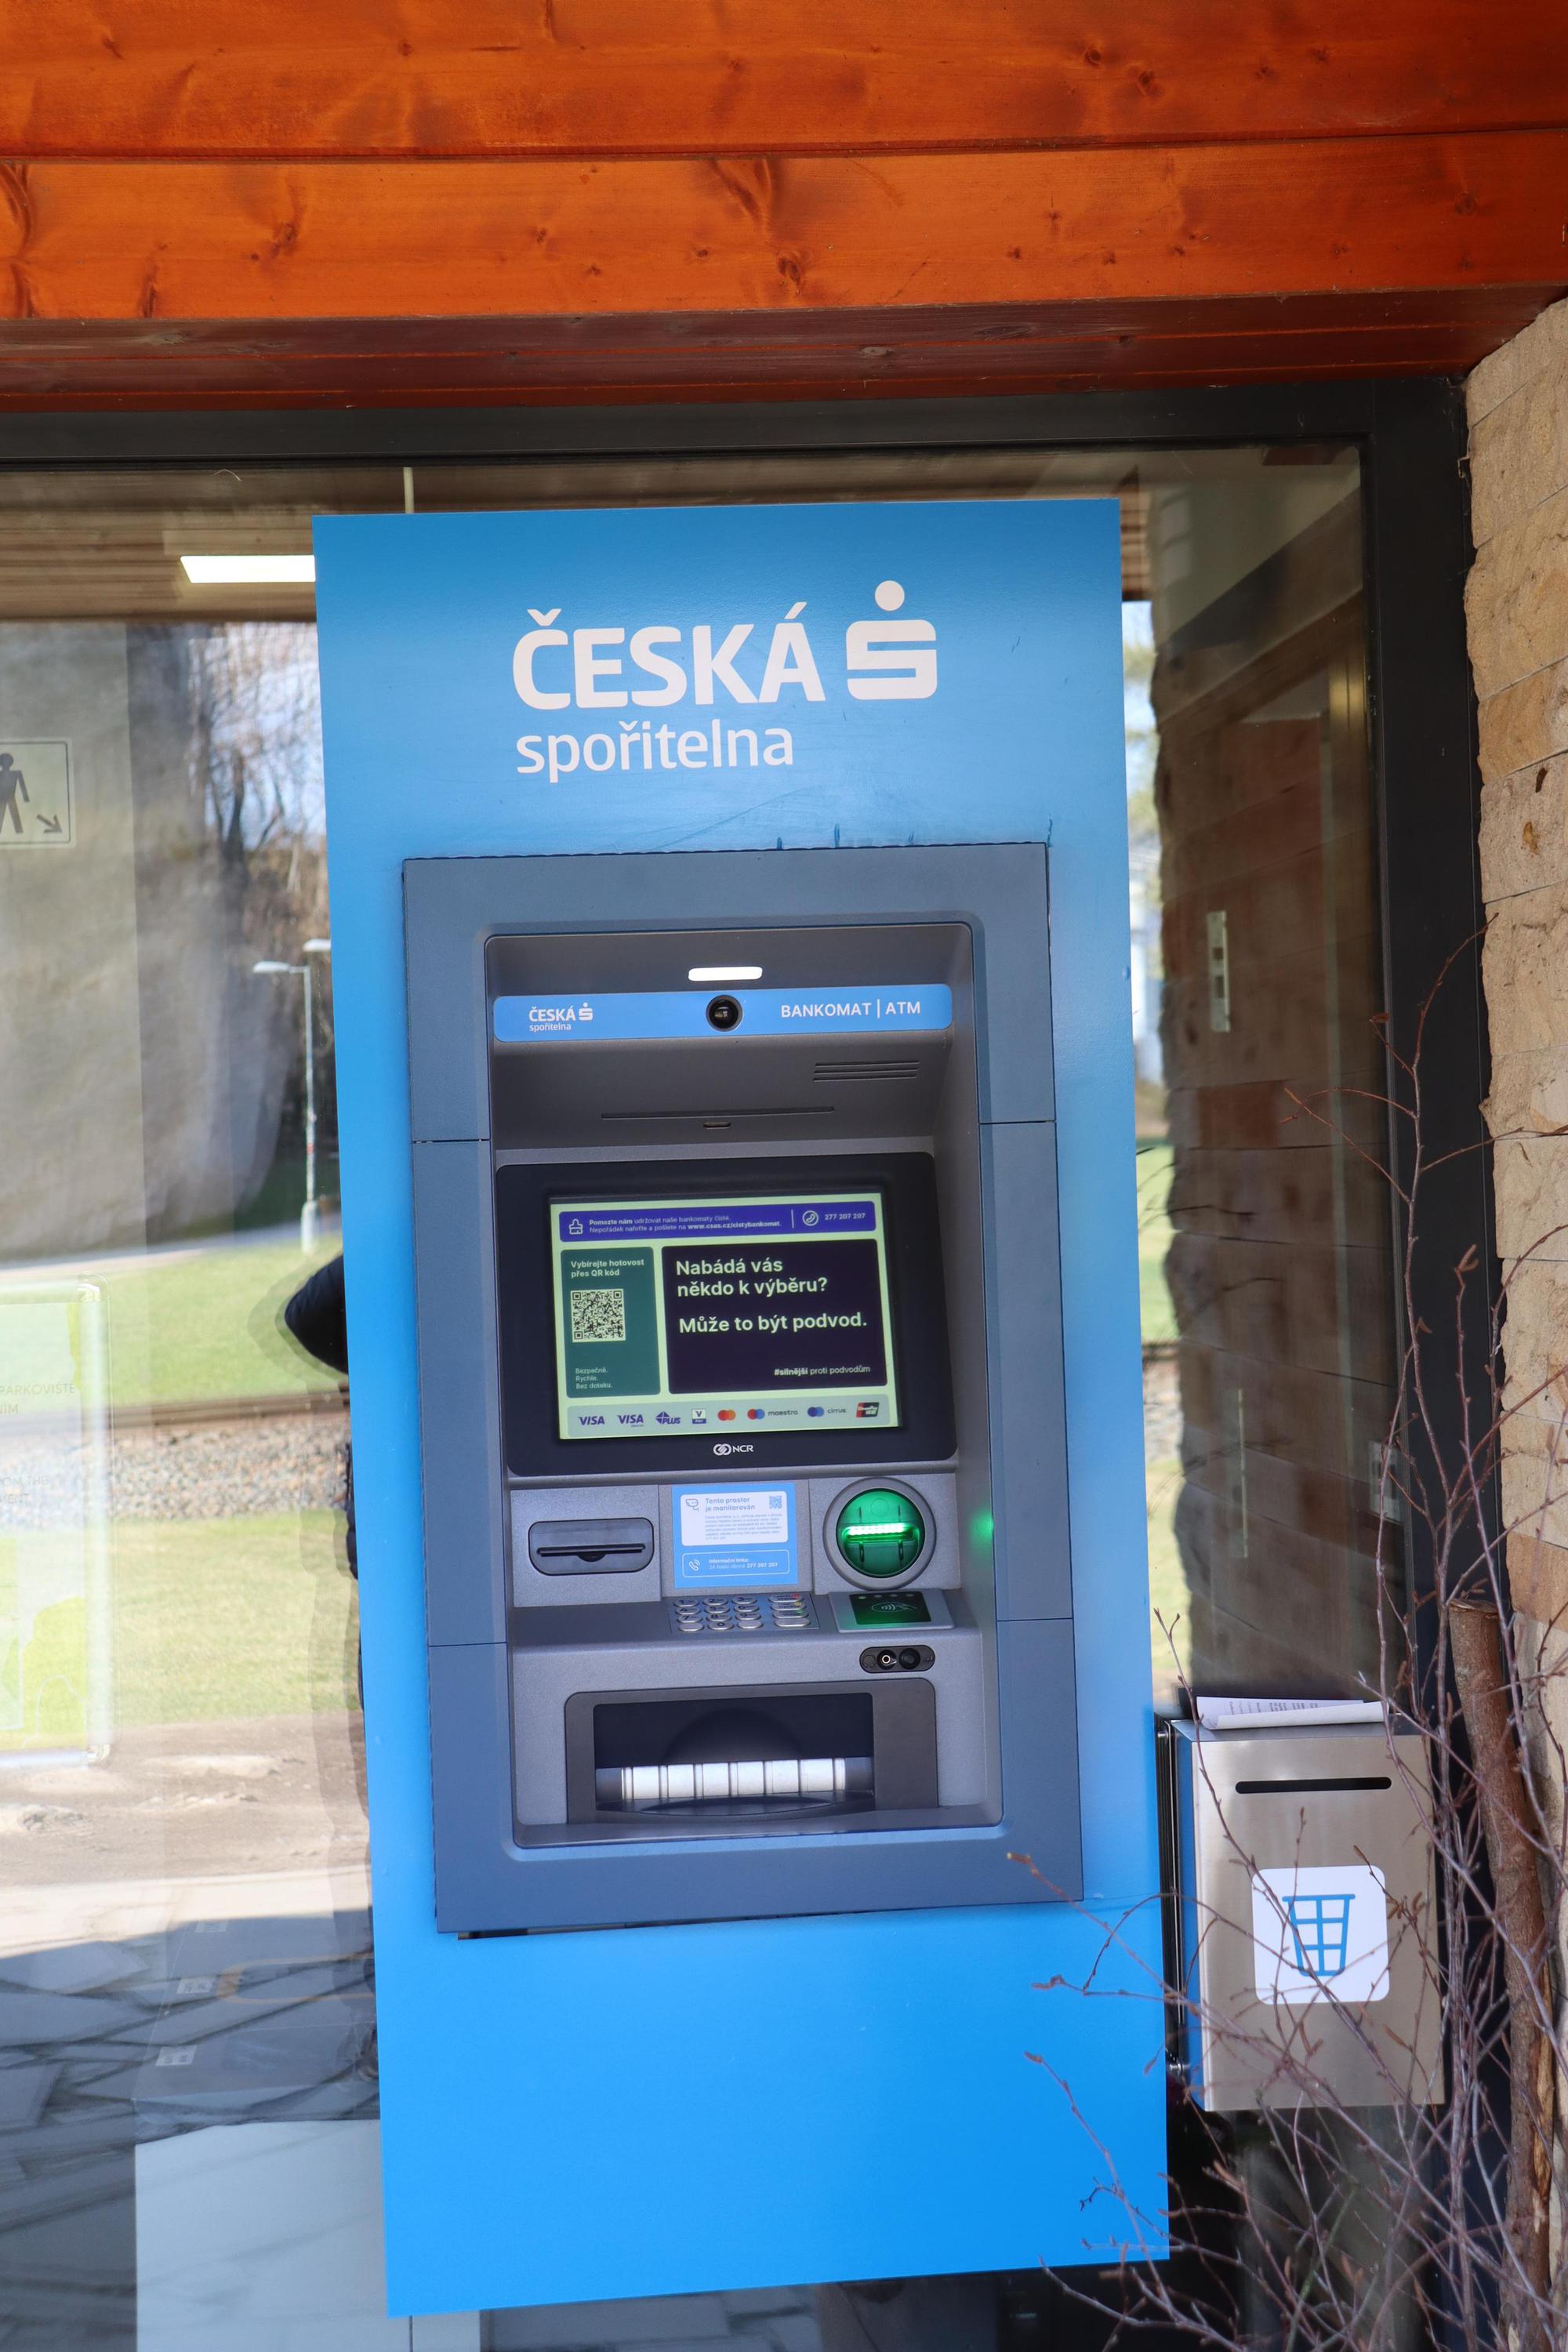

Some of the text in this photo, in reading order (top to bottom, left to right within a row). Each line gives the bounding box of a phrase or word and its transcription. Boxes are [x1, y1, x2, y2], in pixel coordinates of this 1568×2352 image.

[512, 601, 826, 710] ČESKÁ
[516, 719, 793, 783] spořitelna
[528, 1005, 575, 1022] ČESKÁ
[781, 1001, 921, 1018] BANKOMAT ATM
[529, 1022, 572, 1033] spořitelna
[571, 1258, 644, 1269] Vybírejte hotovost
[677, 1257, 783, 1276] Nabádá vás
[571, 1269, 589, 1279] přes
[604, 1268, 620, 1276] kód
[677, 1277, 828, 1298] někdo k výběru?
[679, 1312, 867, 1334] Může to být podvod.
[829, 1365, 871, 1375] podvodům
[579, 1416, 605, 1425] VISA
[616, 1414, 644, 1424] VISA
